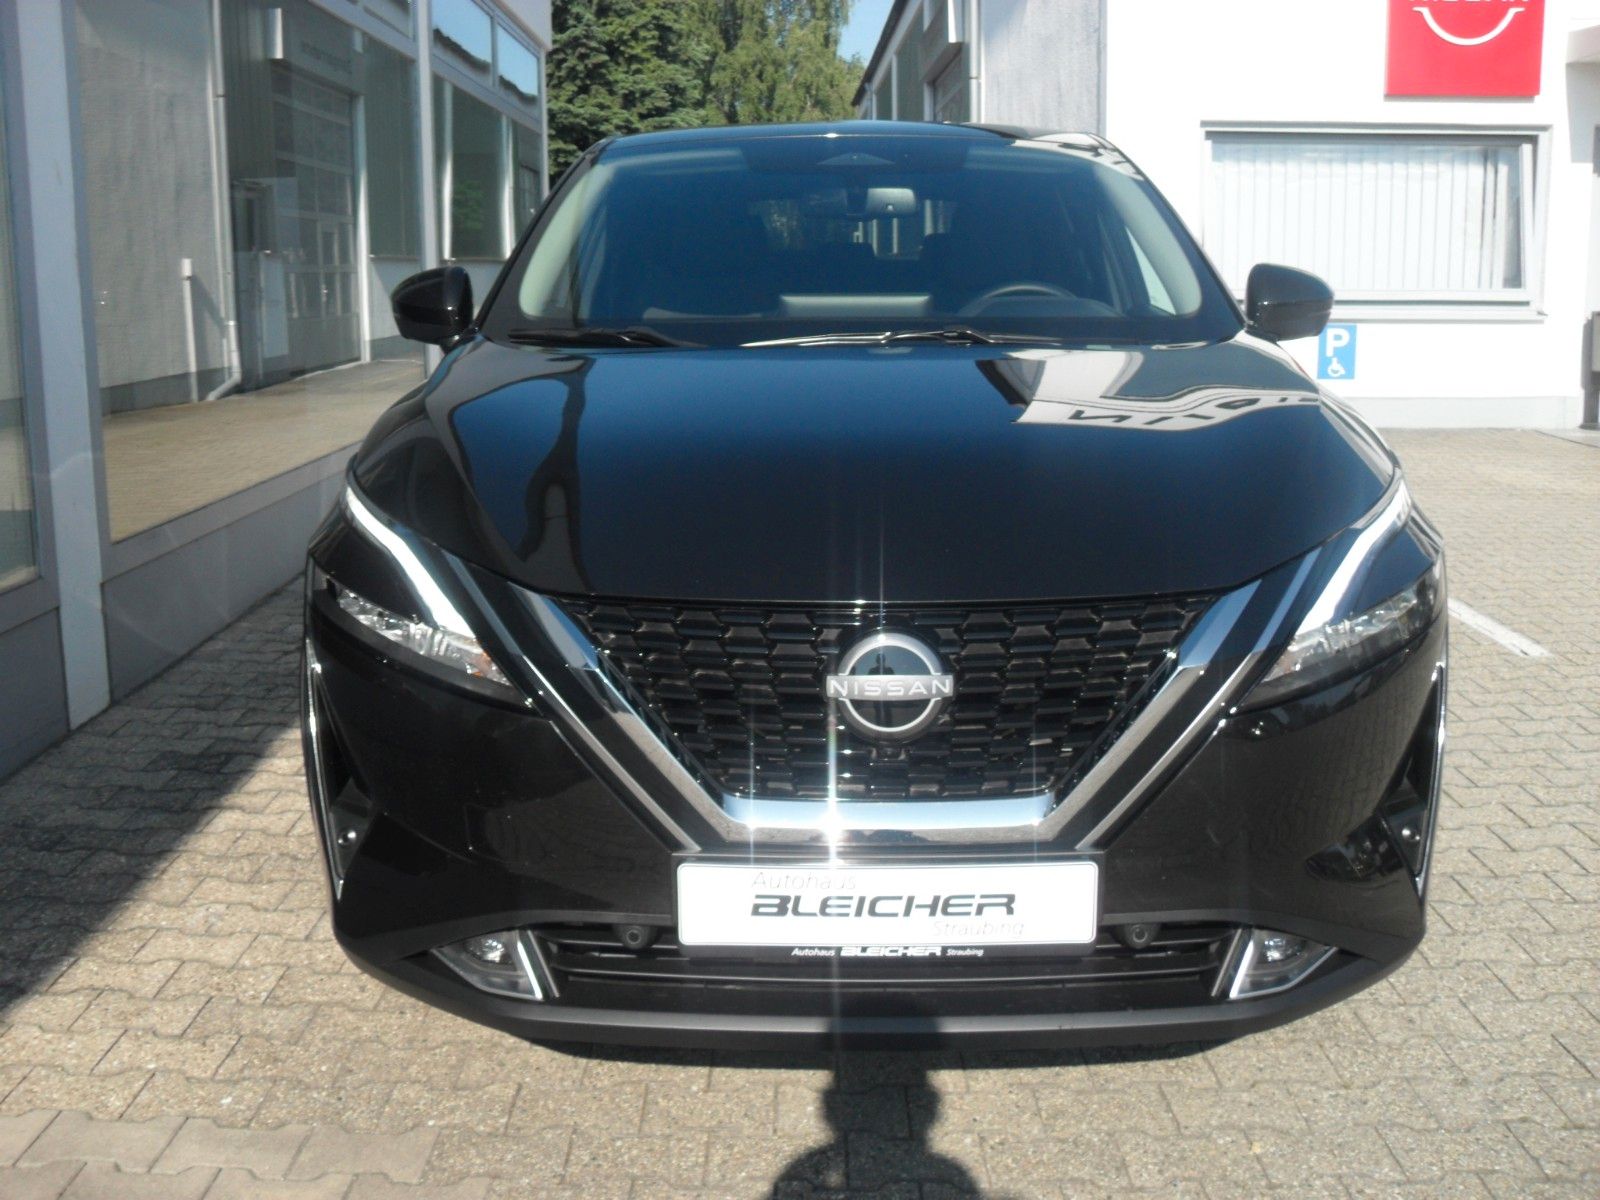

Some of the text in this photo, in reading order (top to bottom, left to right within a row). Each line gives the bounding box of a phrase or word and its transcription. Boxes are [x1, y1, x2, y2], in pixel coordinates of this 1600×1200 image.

[1325, 327, 1350, 358] P
[828, 677, 952, 697] NISSAN
[751, 871, 857, 890] Autohaus
[751, 894, 1016, 918] BLEICHER
[791, 946, 984, 957] Autohaus BLEICHER Straubing
